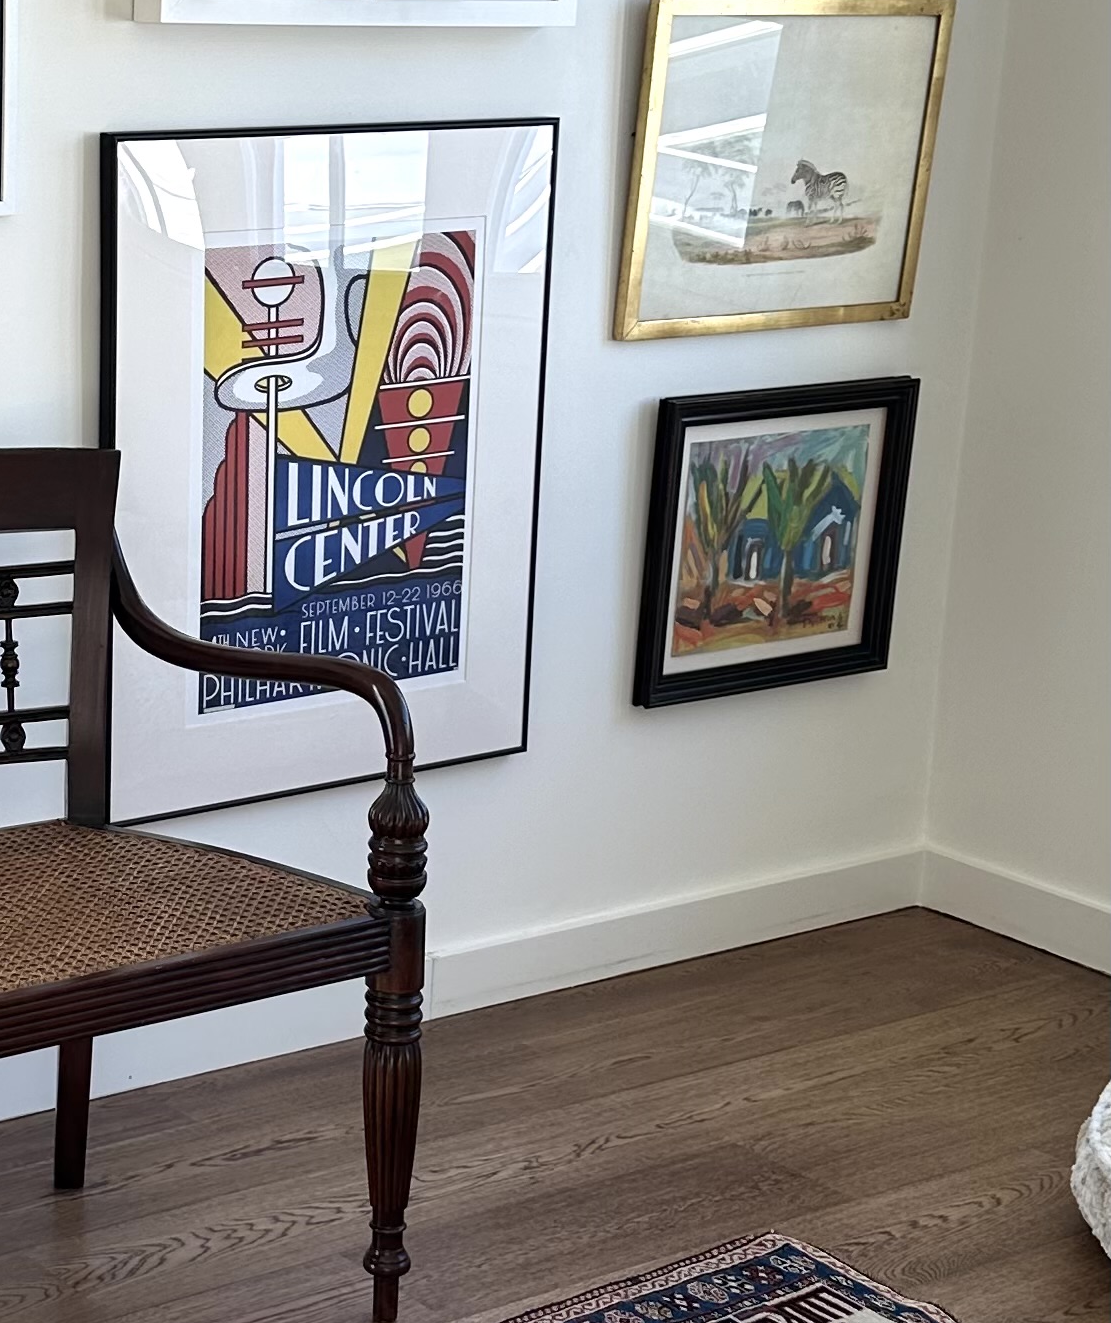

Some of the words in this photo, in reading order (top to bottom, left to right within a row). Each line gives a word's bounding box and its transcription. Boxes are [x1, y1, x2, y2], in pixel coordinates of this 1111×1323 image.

[287, 462, 437, 526] LINCOLN
[284, 511, 421, 591] CENTER
[301, 594, 376, 619] SEPTEMBER
[382, 586, 421, 605] 12-22
[426, 580, 463, 599] 1966
[236, 626, 278, 648] NEW
[300, 616, 349, 655] FILM
[365, 599, 459, 646] FESTIVAL
[408, 636, 458, 674] HALL
